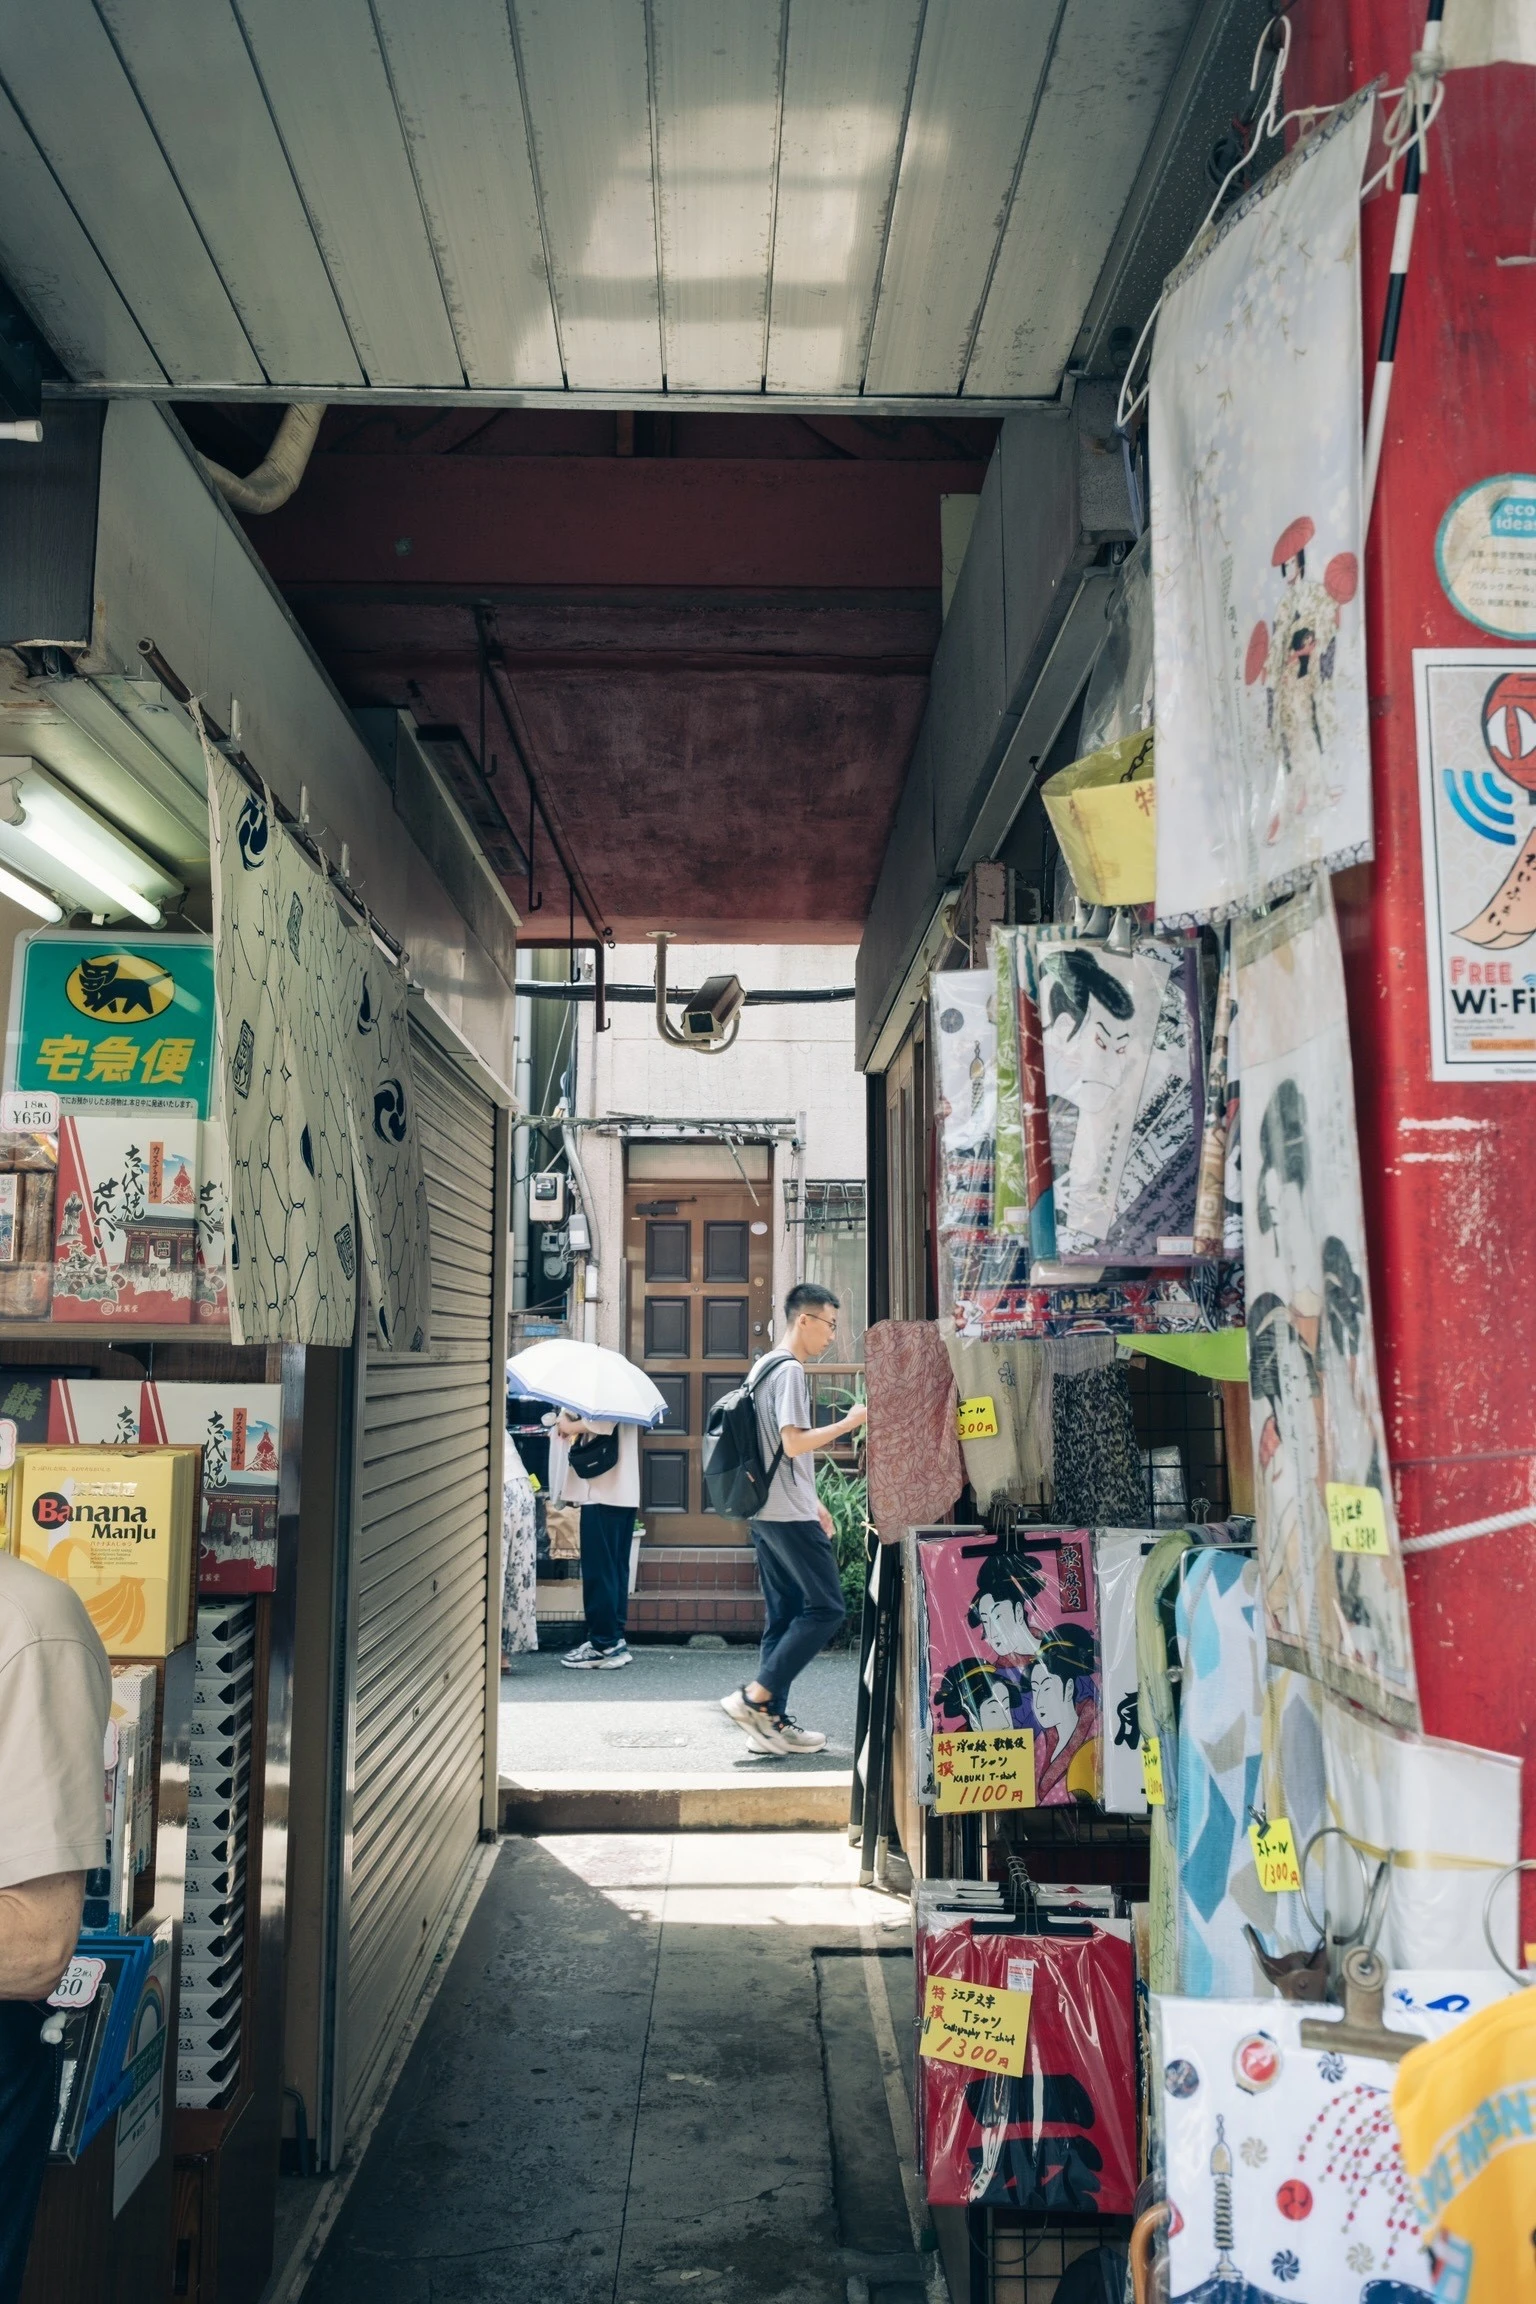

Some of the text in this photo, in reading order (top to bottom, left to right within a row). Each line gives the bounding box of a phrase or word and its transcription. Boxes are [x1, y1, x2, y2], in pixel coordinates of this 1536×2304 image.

[1503, 504, 1535, 515] eco
[1450, 957, 1512, 985] FREE
[1451, 987, 1536, 1014] Wi-Fi
[36, 1034, 196, 1084] 宅急便
[13, 1110, 51, 1125] ¥650
[121, 1144, 146, 1221] 古代焼
[93, 1177, 120, 1249] せんべい
[956, 1407, 986, 1417] トール
[37, 1499, 148, 1524] Banana
[970, 1755, 1008, 1769] Tシャツ
[953, 1774, 985, 1783] KABUKI
[959, 1784, 1023, 1805] 1100円
[951, 1988, 996, 2010] 江戸文字
[962, 2009, 1002, 2029] Tシャツ
[936, 2036, 1010, 2070] 1300円
